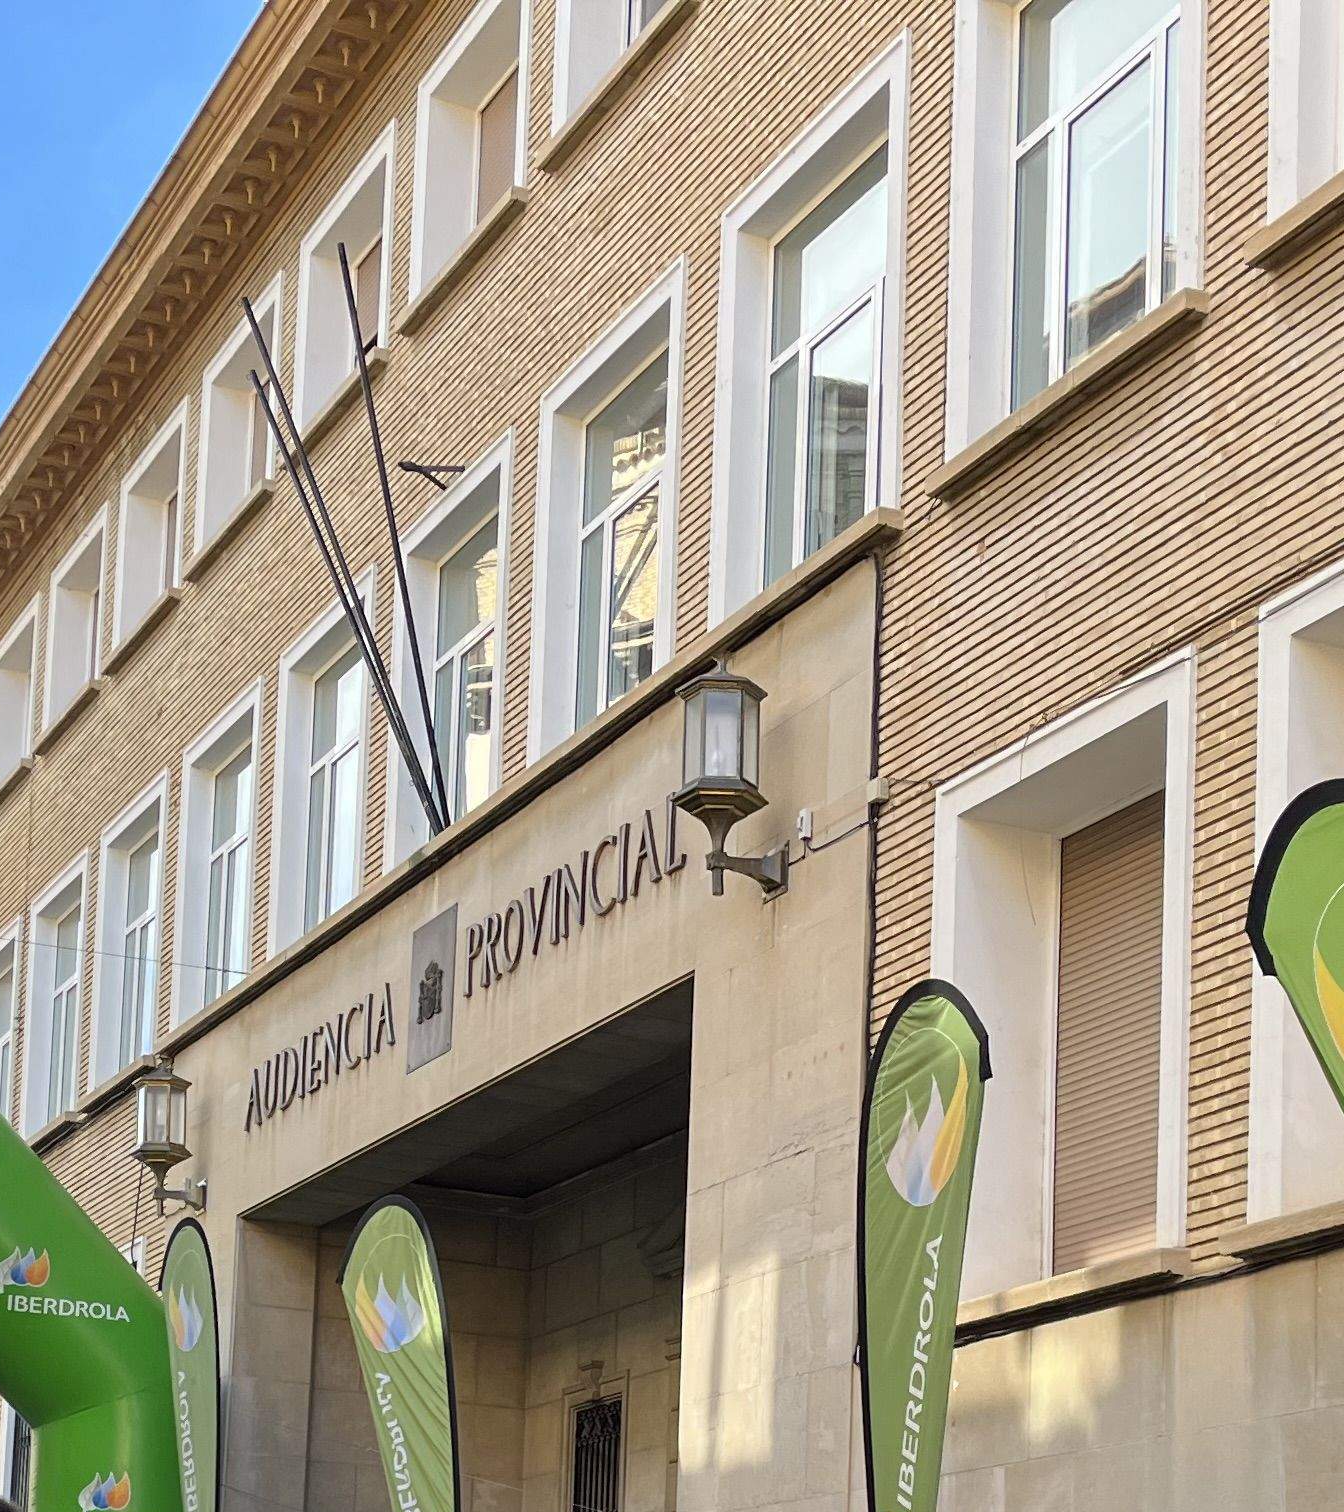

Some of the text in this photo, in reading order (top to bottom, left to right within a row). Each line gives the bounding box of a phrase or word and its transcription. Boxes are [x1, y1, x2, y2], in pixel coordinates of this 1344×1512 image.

[242, 792, 688, 1132] AUDIENCIA PROVINCIAL
[7, 1294, 131, 1323] IBERDROLA
[896, 1233, 943, 1511] IBERDROLA
